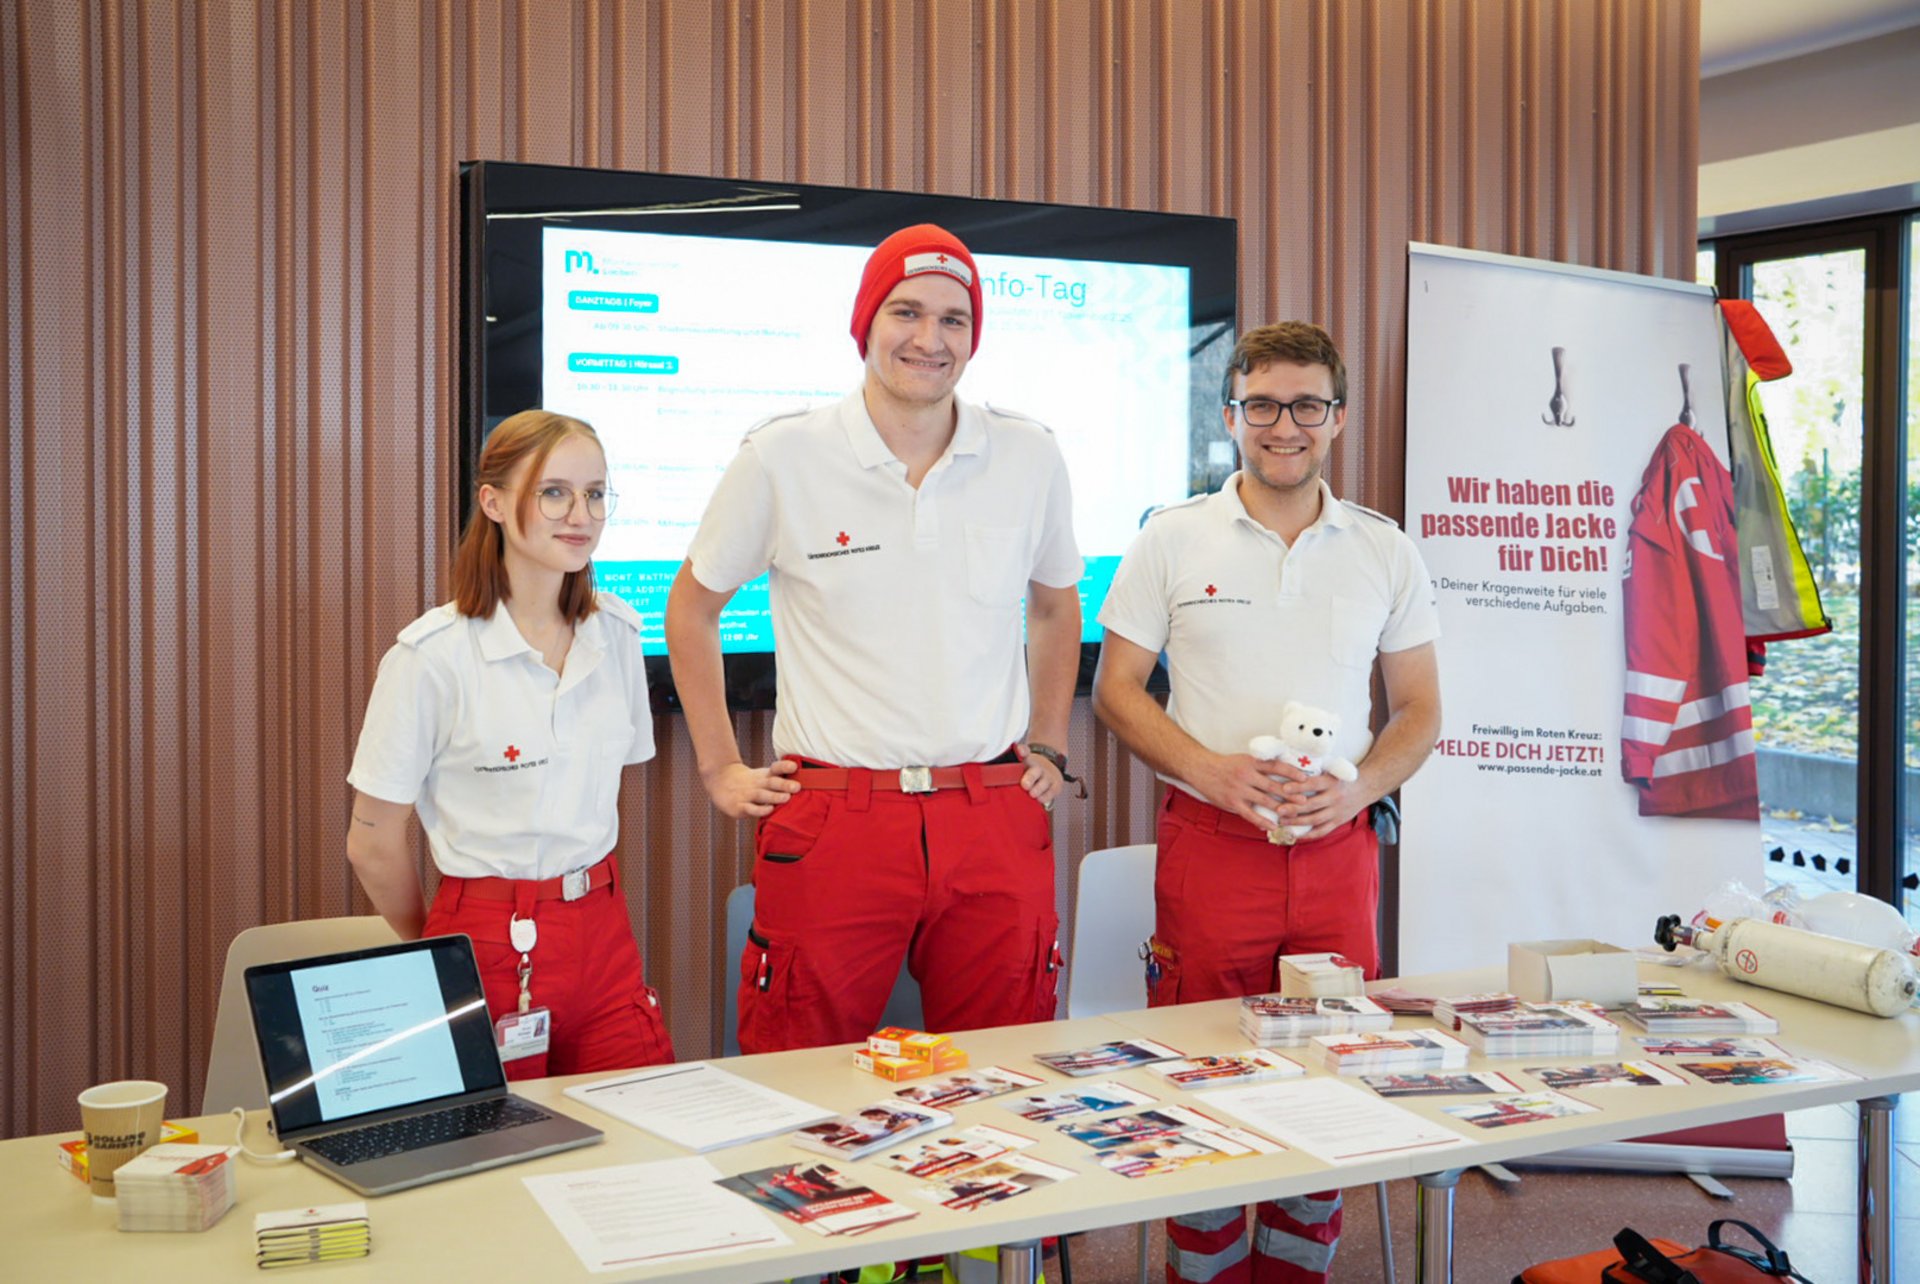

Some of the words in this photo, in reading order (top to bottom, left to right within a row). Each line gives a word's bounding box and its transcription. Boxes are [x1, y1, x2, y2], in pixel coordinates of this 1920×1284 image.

[979, 271, 1087, 307] nfo-Tag
[1447, 476, 1490, 503] Wir
[1496, 478, 1571, 507] haben
[1577, 481, 1614, 507] die
[1421, 512, 1540, 539] passende
[1545, 513, 1616, 539] Jacke
[1498, 545, 1534, 572] für
[1540, 545, 1608, 573] Dich!
[1441, 577, 1479, 591] Deiner
[1482, 580, 1555, 599] Kragenweite
[1558, 585, 1576, 598] für
[1579, 586, 1607, 600] viele
[1465, 596, 1542, 611] verschiedene
[1544, 599, 1608, 615] Aufgaben.
[1472, 724, 1519, 739] Freiwillig
[1520, 727, 1534, 737] im
[1536, 728, 1566, 739] Roten
[1568, 729, 1602, 741] Kreuz:
[1496, 742, 1542, 761] DICH
[1545, 744, 1604, 763] JETZT!
[1477, 762, 1603, 777] www.passende-jacke.at
